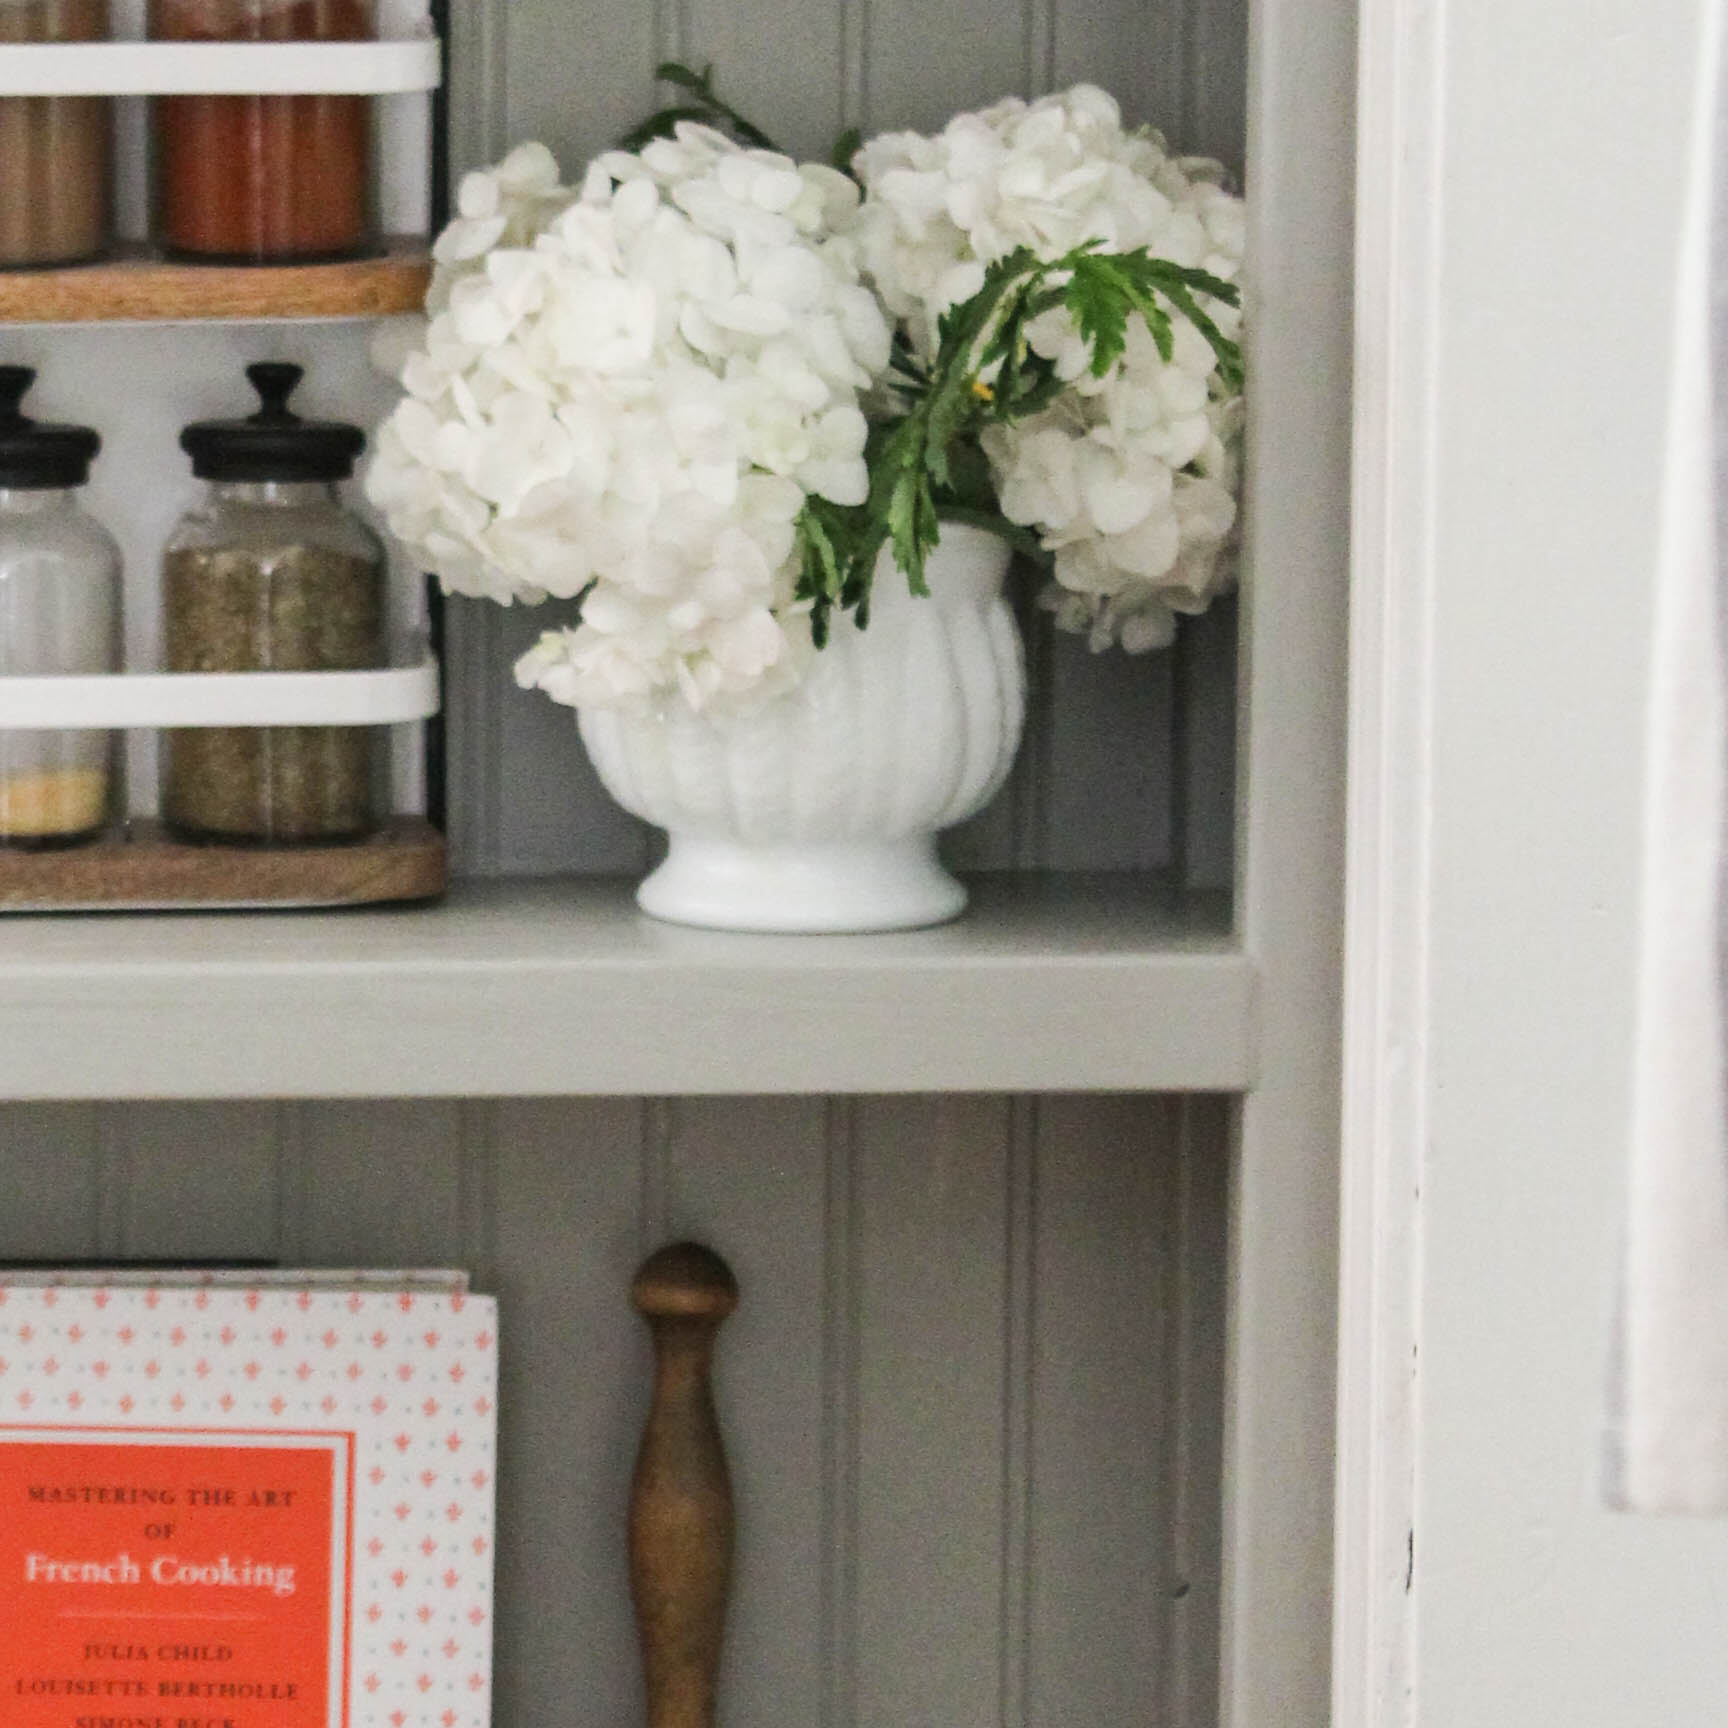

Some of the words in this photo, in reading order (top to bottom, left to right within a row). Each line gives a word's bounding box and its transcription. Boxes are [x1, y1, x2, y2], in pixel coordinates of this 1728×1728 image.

[28, 1486, 175, 1505] MASTERING
[187, 1488, 236, 1508] THE
[246, 1489, 297, 1508] ART
[143, 1522, 176, 1540] OF
[25, 1551, 141, 1584] French
[149, 1553, 296, 1595] Cooking
[83, 1644, 149, 1662] JULIA
[156, 1644, 233, 1662] CHILD
[15, 1678, 147, 1697] LOUISETTE
[156, 1680, 299, 1701] BERTHOLLE
